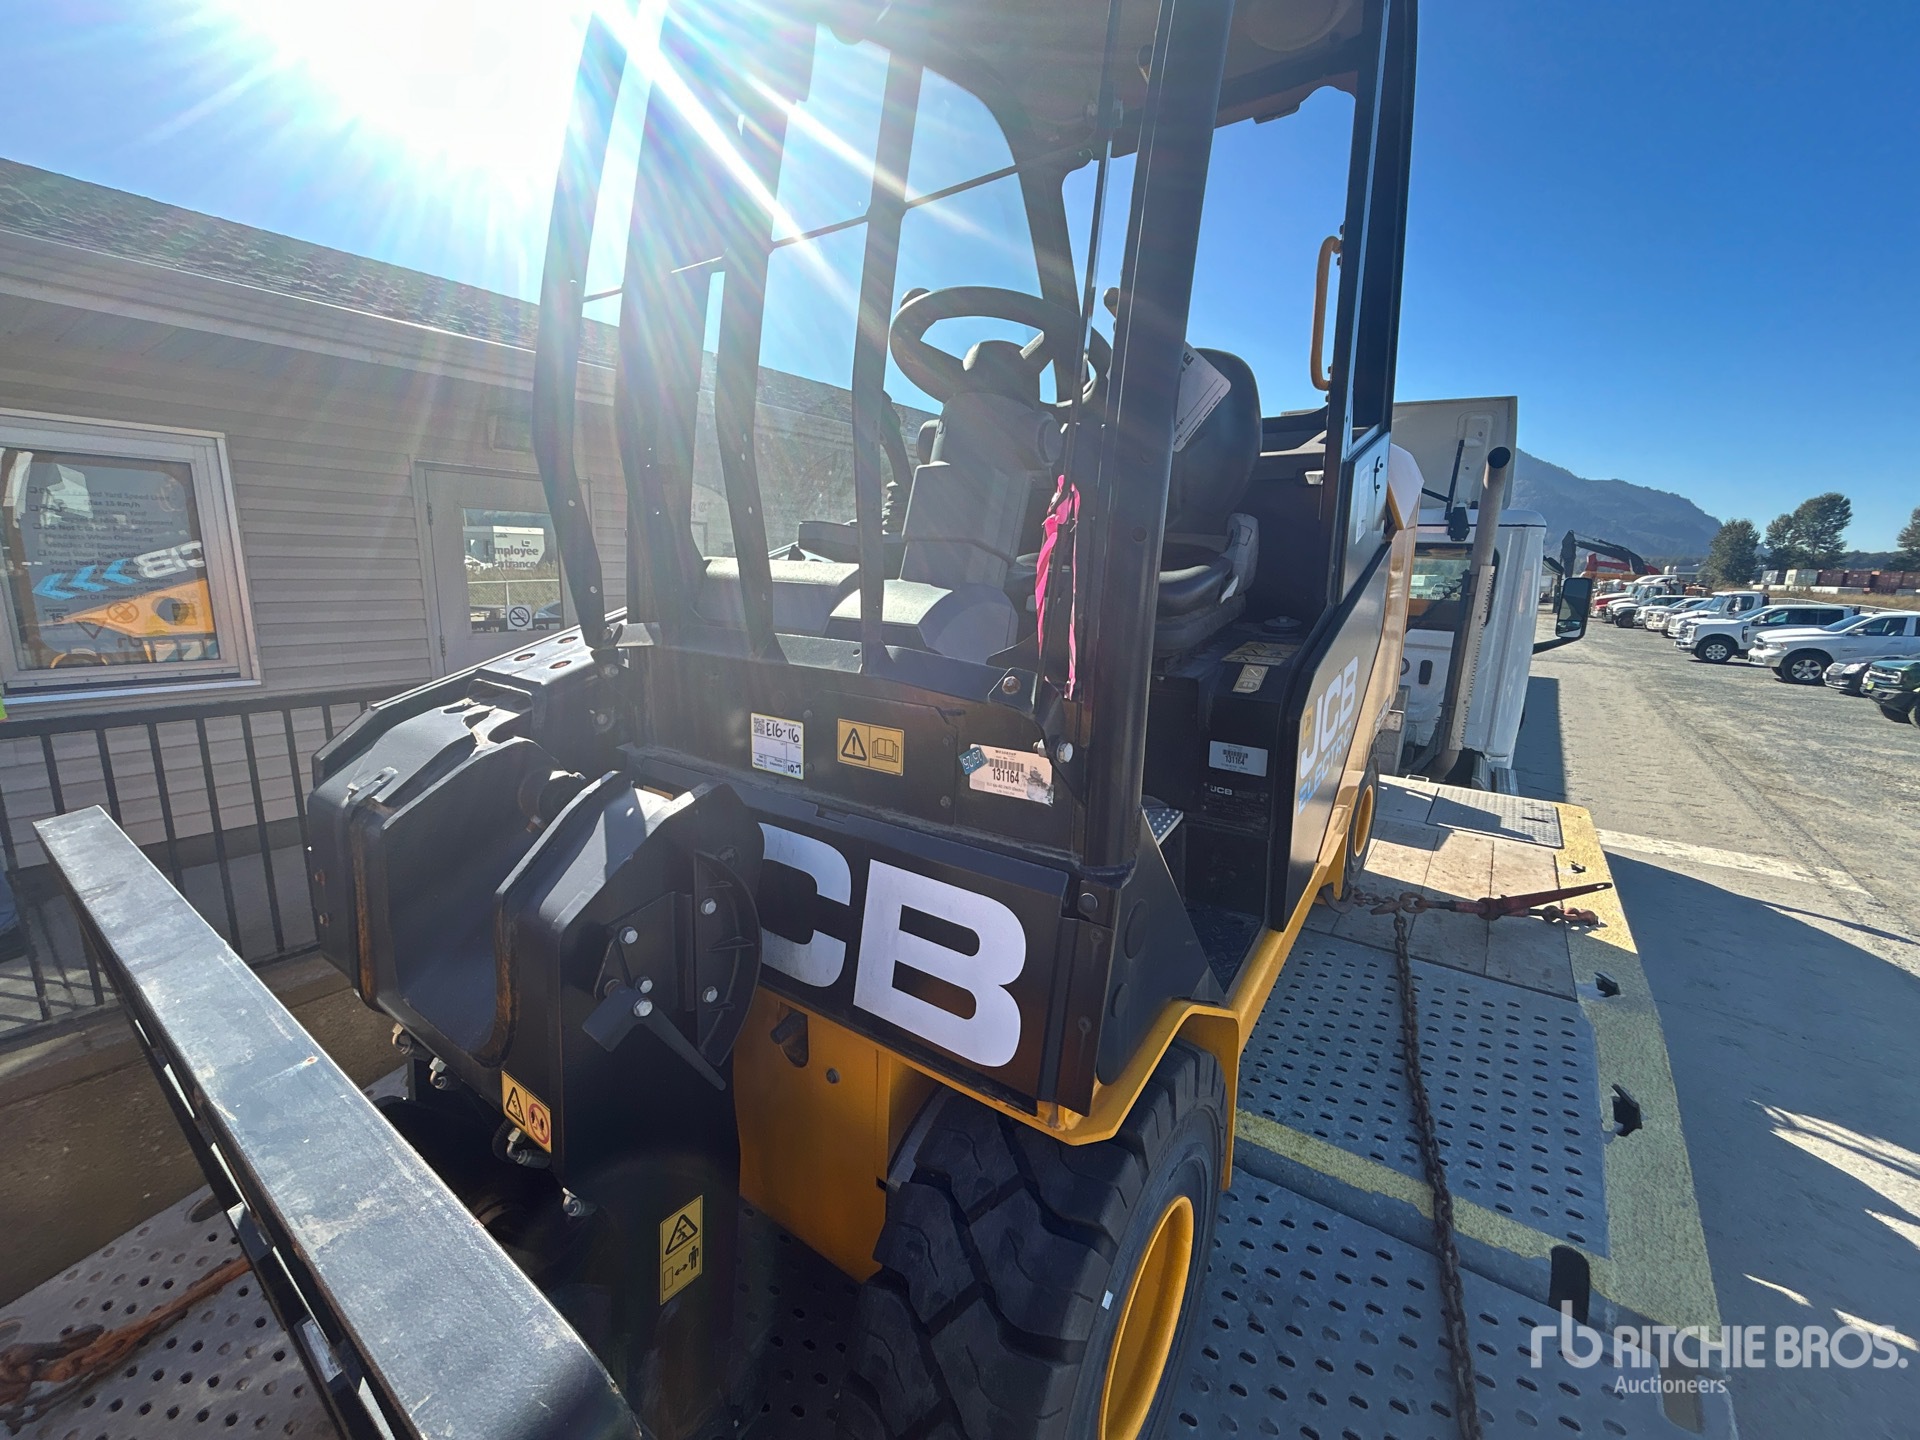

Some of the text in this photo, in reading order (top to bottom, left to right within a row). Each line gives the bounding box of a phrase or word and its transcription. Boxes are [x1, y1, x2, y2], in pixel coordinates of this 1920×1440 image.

[1300, 656, 1359, 778] JCB
[992, 767, 1020, 784] 131164
[1210, 785, 1233, 796] JCB
[1298, 720, 1353, 816] ELECTRC
[758, 822, 1027, 1067] CB
